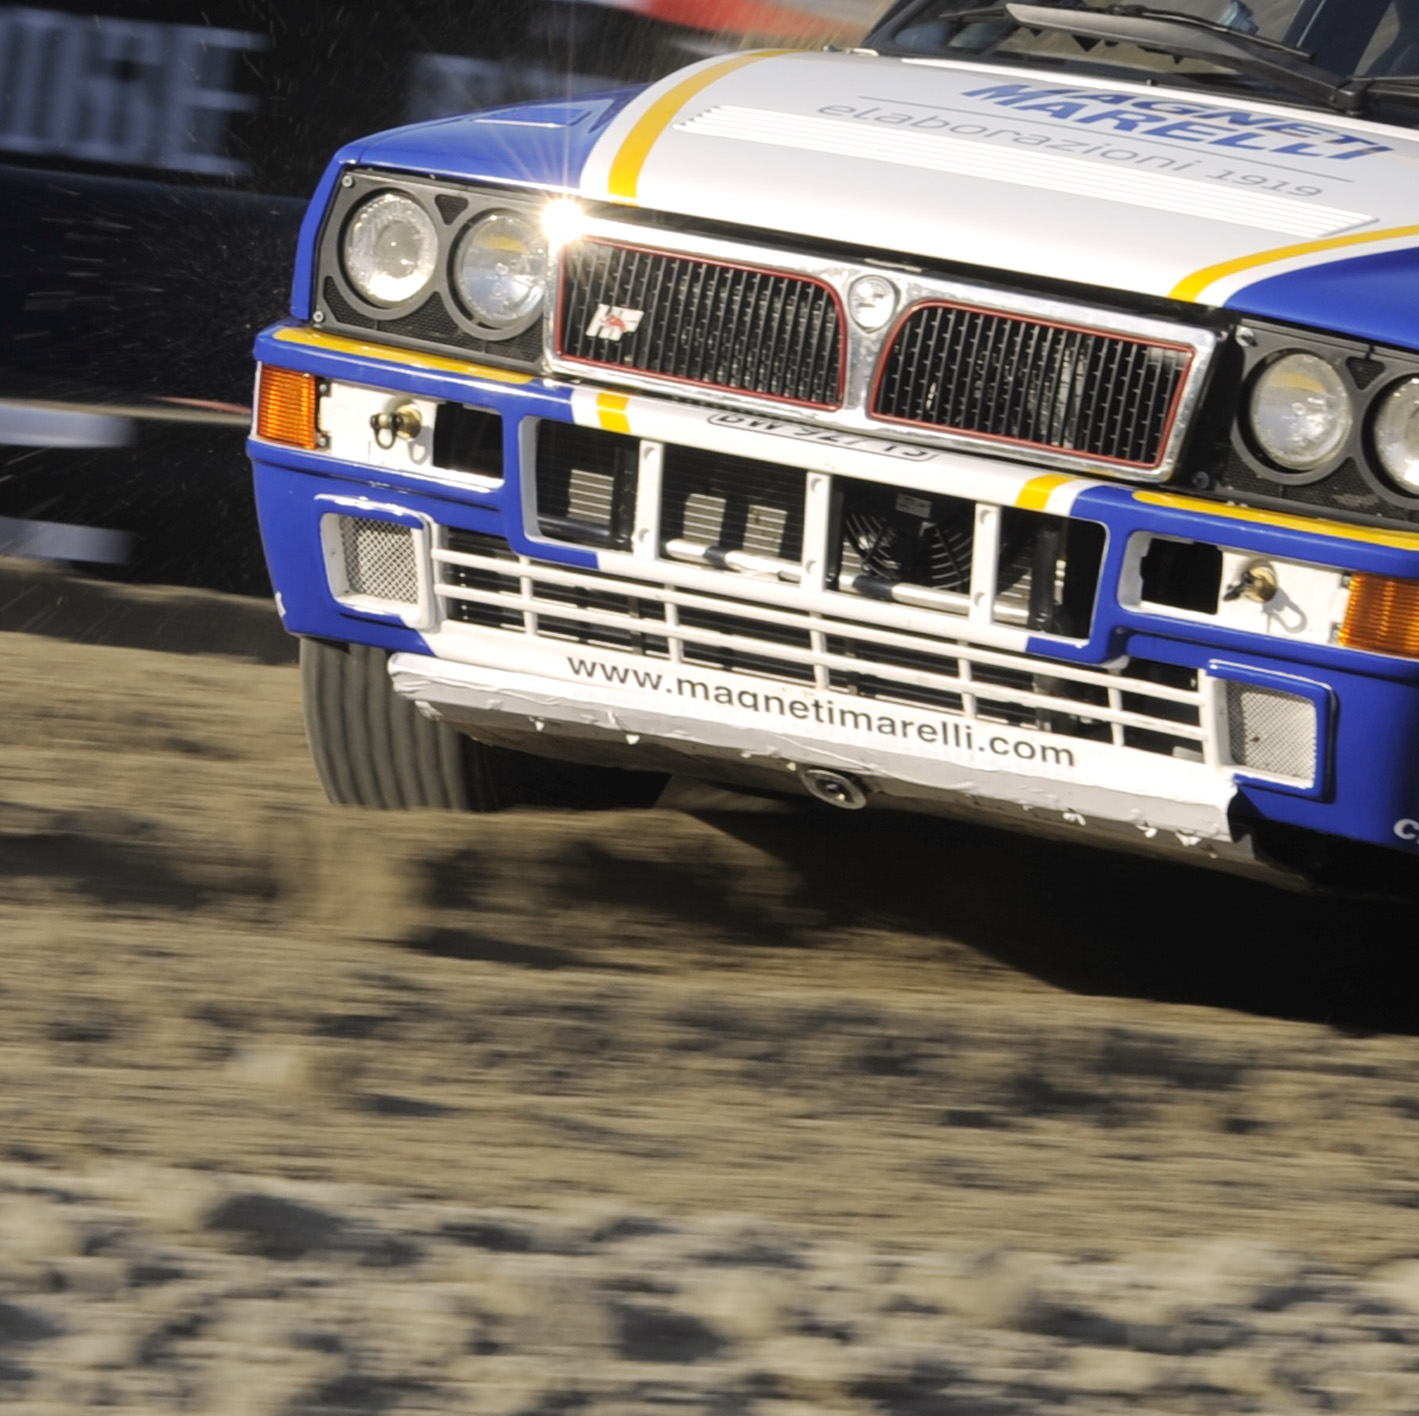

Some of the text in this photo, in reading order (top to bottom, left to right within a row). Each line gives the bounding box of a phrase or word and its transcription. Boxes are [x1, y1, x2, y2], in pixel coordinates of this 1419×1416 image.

[816, 103, 1324, 198] elaborazioni 1919
[961, 84, 1394, 152] MAGNETI
[961, 85, 1394, 160] MARELLI
[566, 655, 1076, 767] www.magnetimarelli.com
